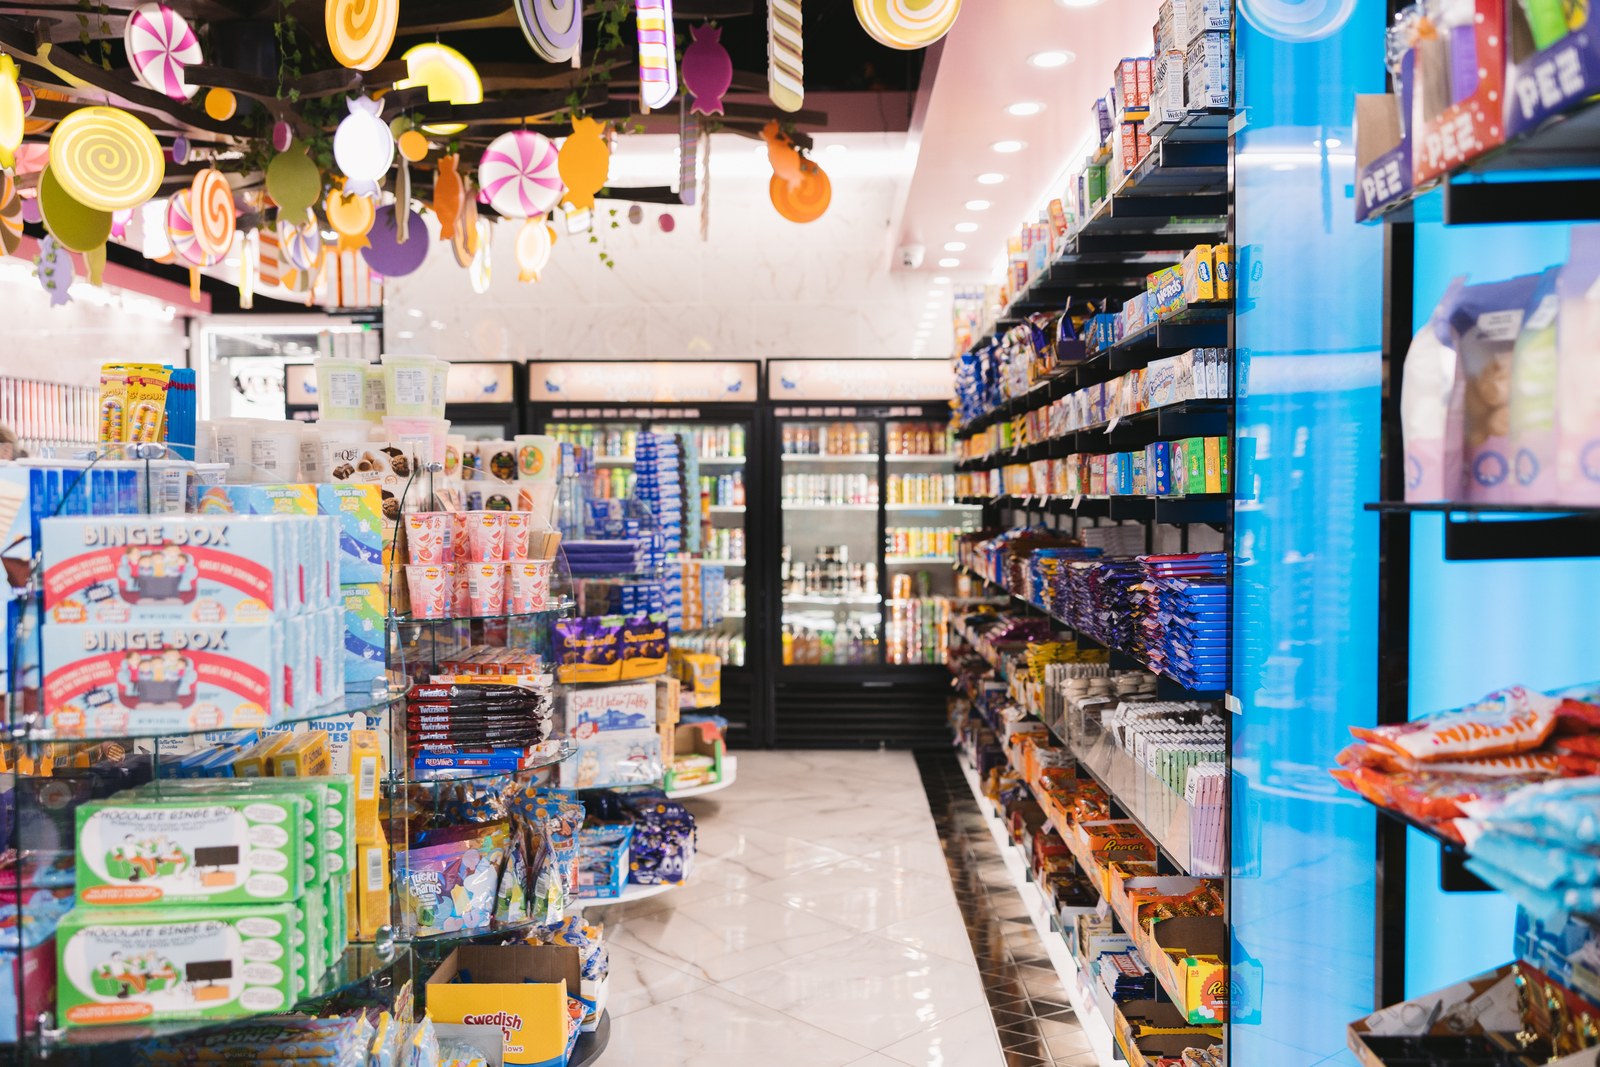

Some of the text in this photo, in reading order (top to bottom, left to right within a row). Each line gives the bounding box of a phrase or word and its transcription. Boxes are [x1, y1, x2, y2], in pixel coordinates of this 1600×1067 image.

[1517, 47, 1585, 119] PEZ
[1426, 111, 1476, 168] PEZ
[1361, 160, 1402, 208] PEZ
[140, 392, 165, 400] SOUR
[84, 525, 230, 546] BINGE BOX
[341, 588, 354, 596] WISS
[84, 630, 228, 650] BINGE BOX
[595, 692, 625, 709] Water
[624, 692, 649, 709] Taffy
[309, 721, 354, 731] MUDDY
[170, 809, 212, 820] BINGE
[215, 806, 240, 817] BOX
[1104, 840, 1146, 851] Reese's
[411, 871, 438, 887] Lucky
[409, 882, 442, 897] Charms
[159, 924, 200, 937] BINGE
[206, 920, 232, 932] BOX
[463, 1012, 522, 1029] Swedish
